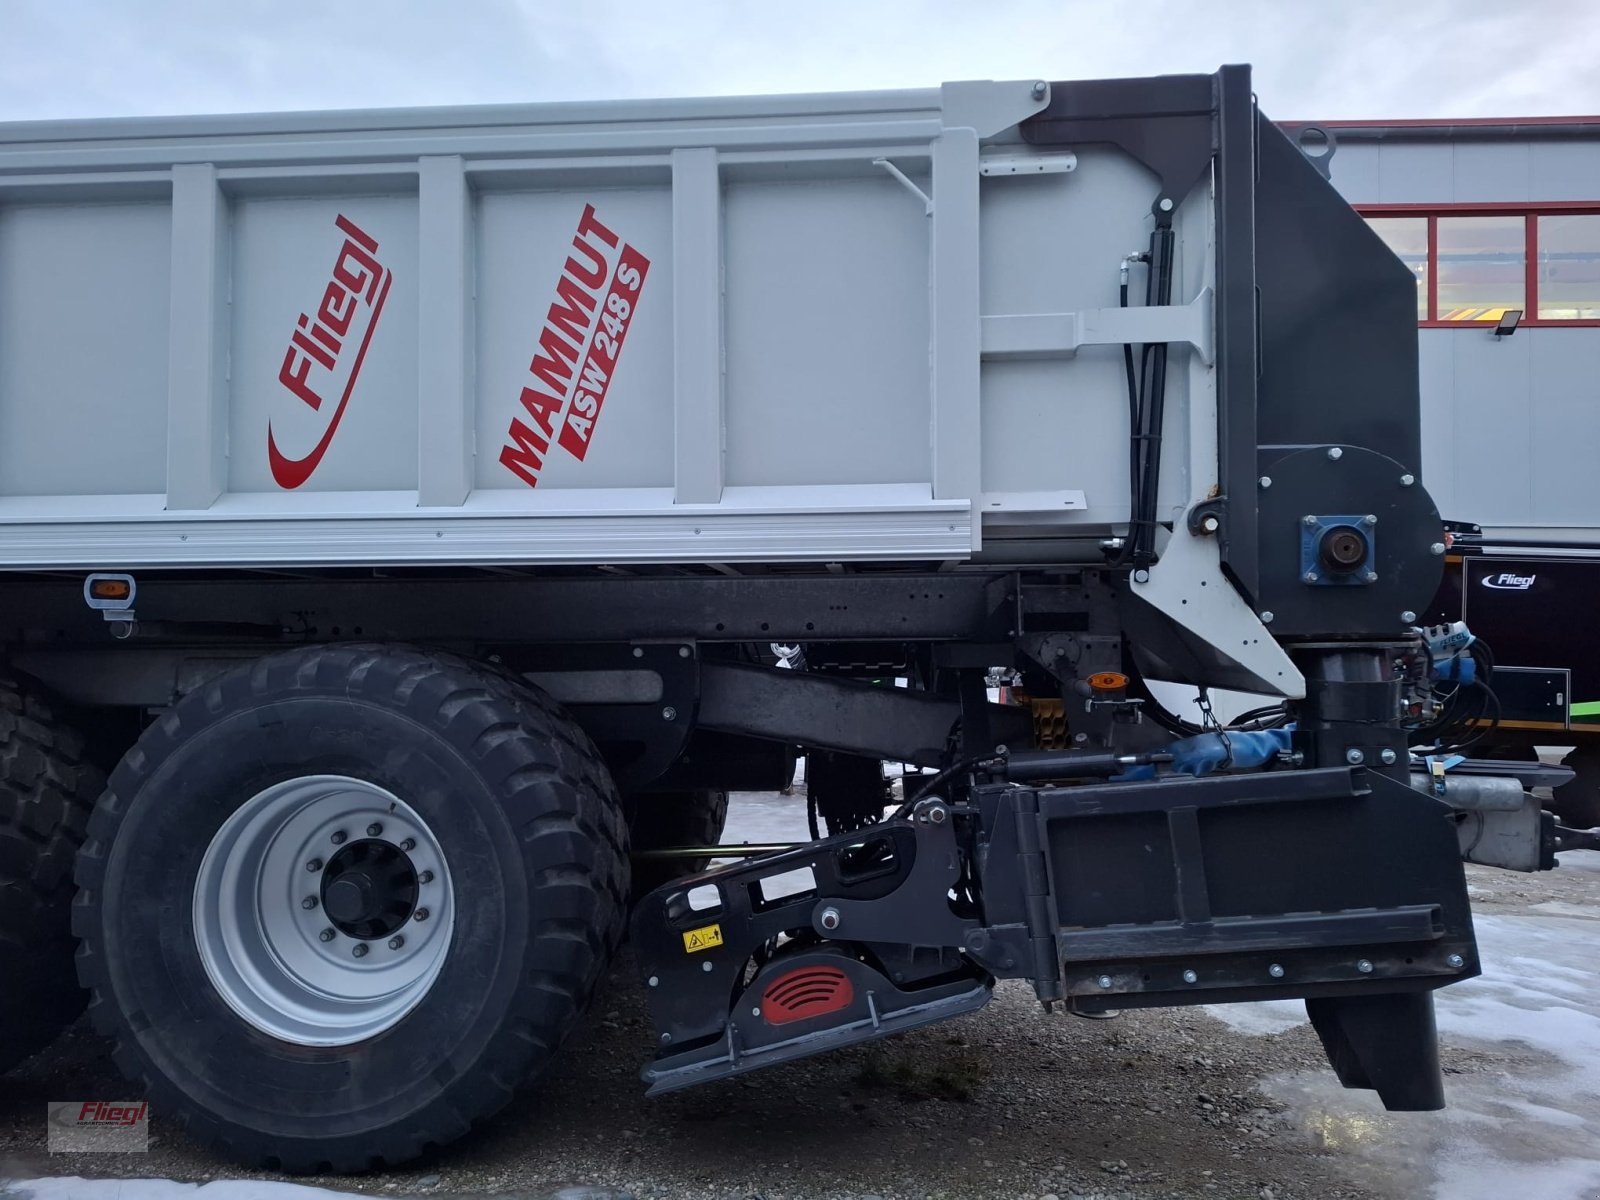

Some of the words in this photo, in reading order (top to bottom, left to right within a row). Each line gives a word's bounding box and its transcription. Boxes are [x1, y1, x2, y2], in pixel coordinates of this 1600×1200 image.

[278, 213, 384, 412] Fliegl
[499, 202, 620, 488] MAMMUT
[567, 356, 608, 442] ASW
[594, 291, 631, 360] 248
[617, 262, 641, 291] S
[1497, 573, 1537, 588] Fliegl
